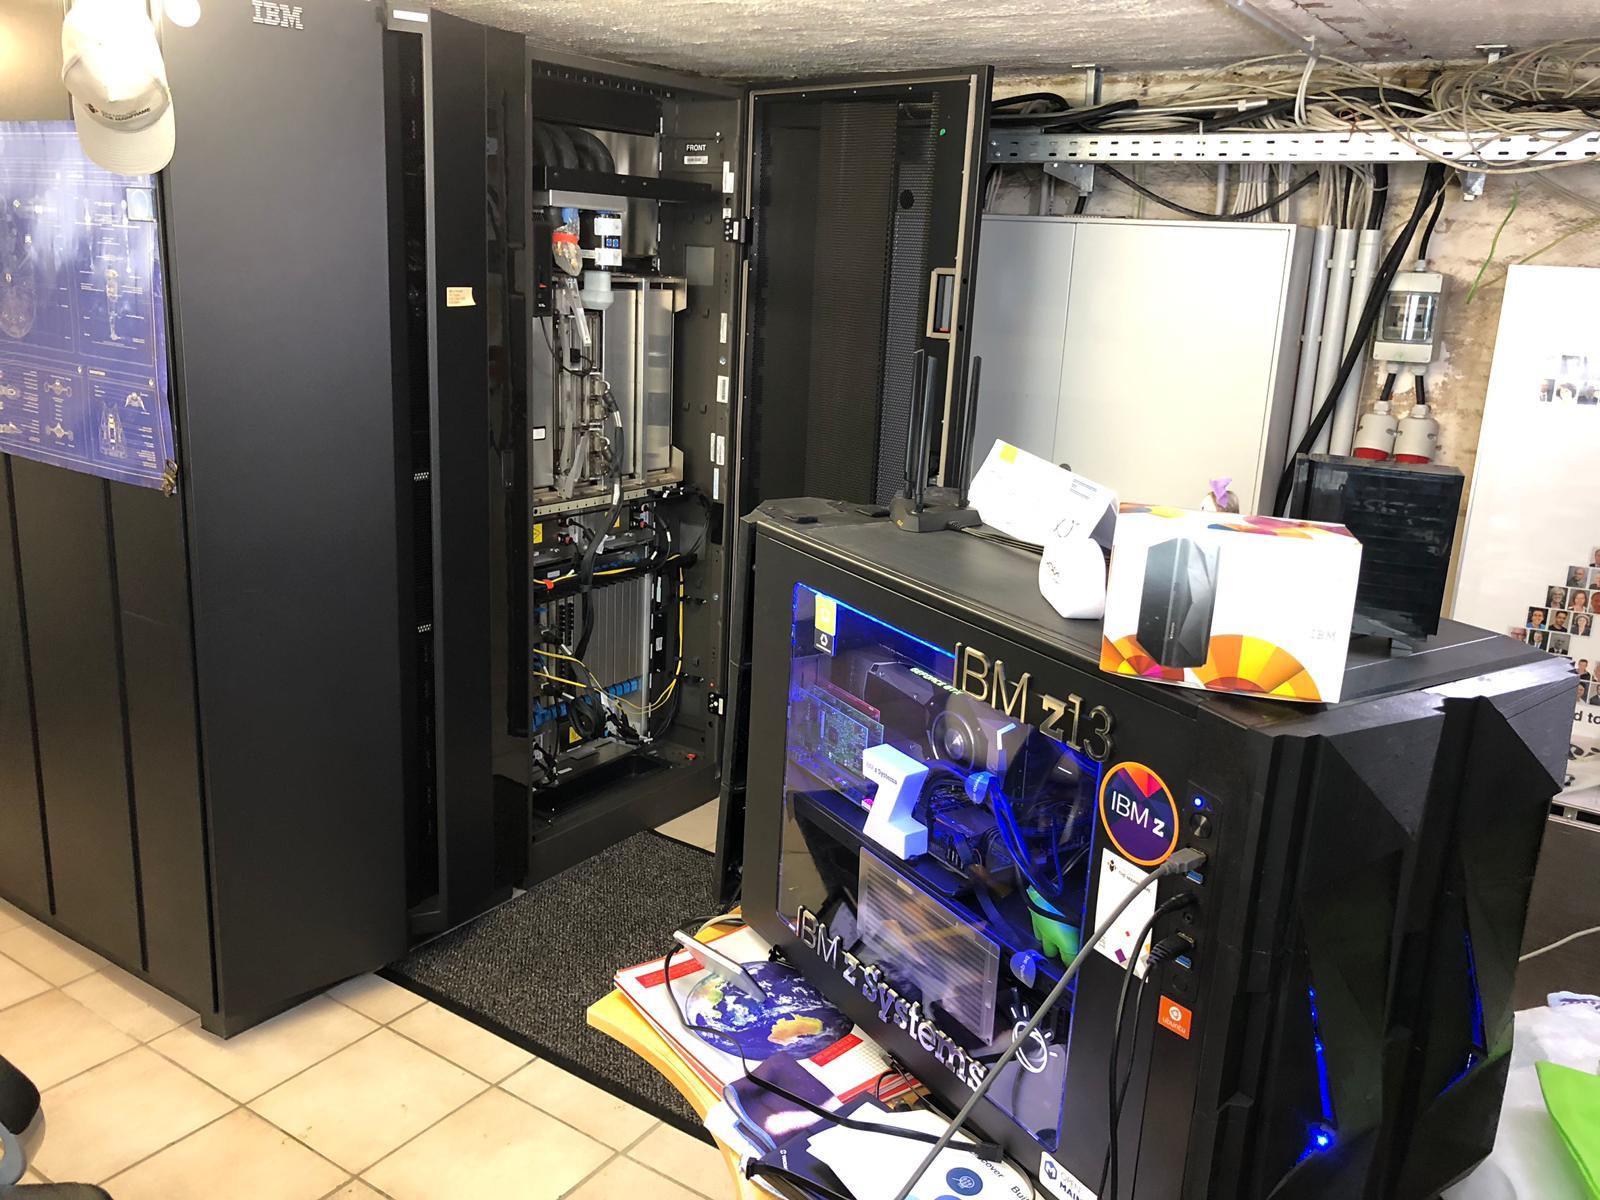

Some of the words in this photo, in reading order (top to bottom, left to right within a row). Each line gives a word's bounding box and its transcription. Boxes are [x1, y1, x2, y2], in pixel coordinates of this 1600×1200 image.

[252, 0, 304, 30] IBM
[952, 642, 1031, 724] IBM
[1039, 692, 1116, 763] z13
[1111, 790, 1149, 829] IBM
[795, 905, 841, 970] IBM
[862, 964, 989, 1093] Systems
[1162, 1017, 1186, 1034] ubuntu
